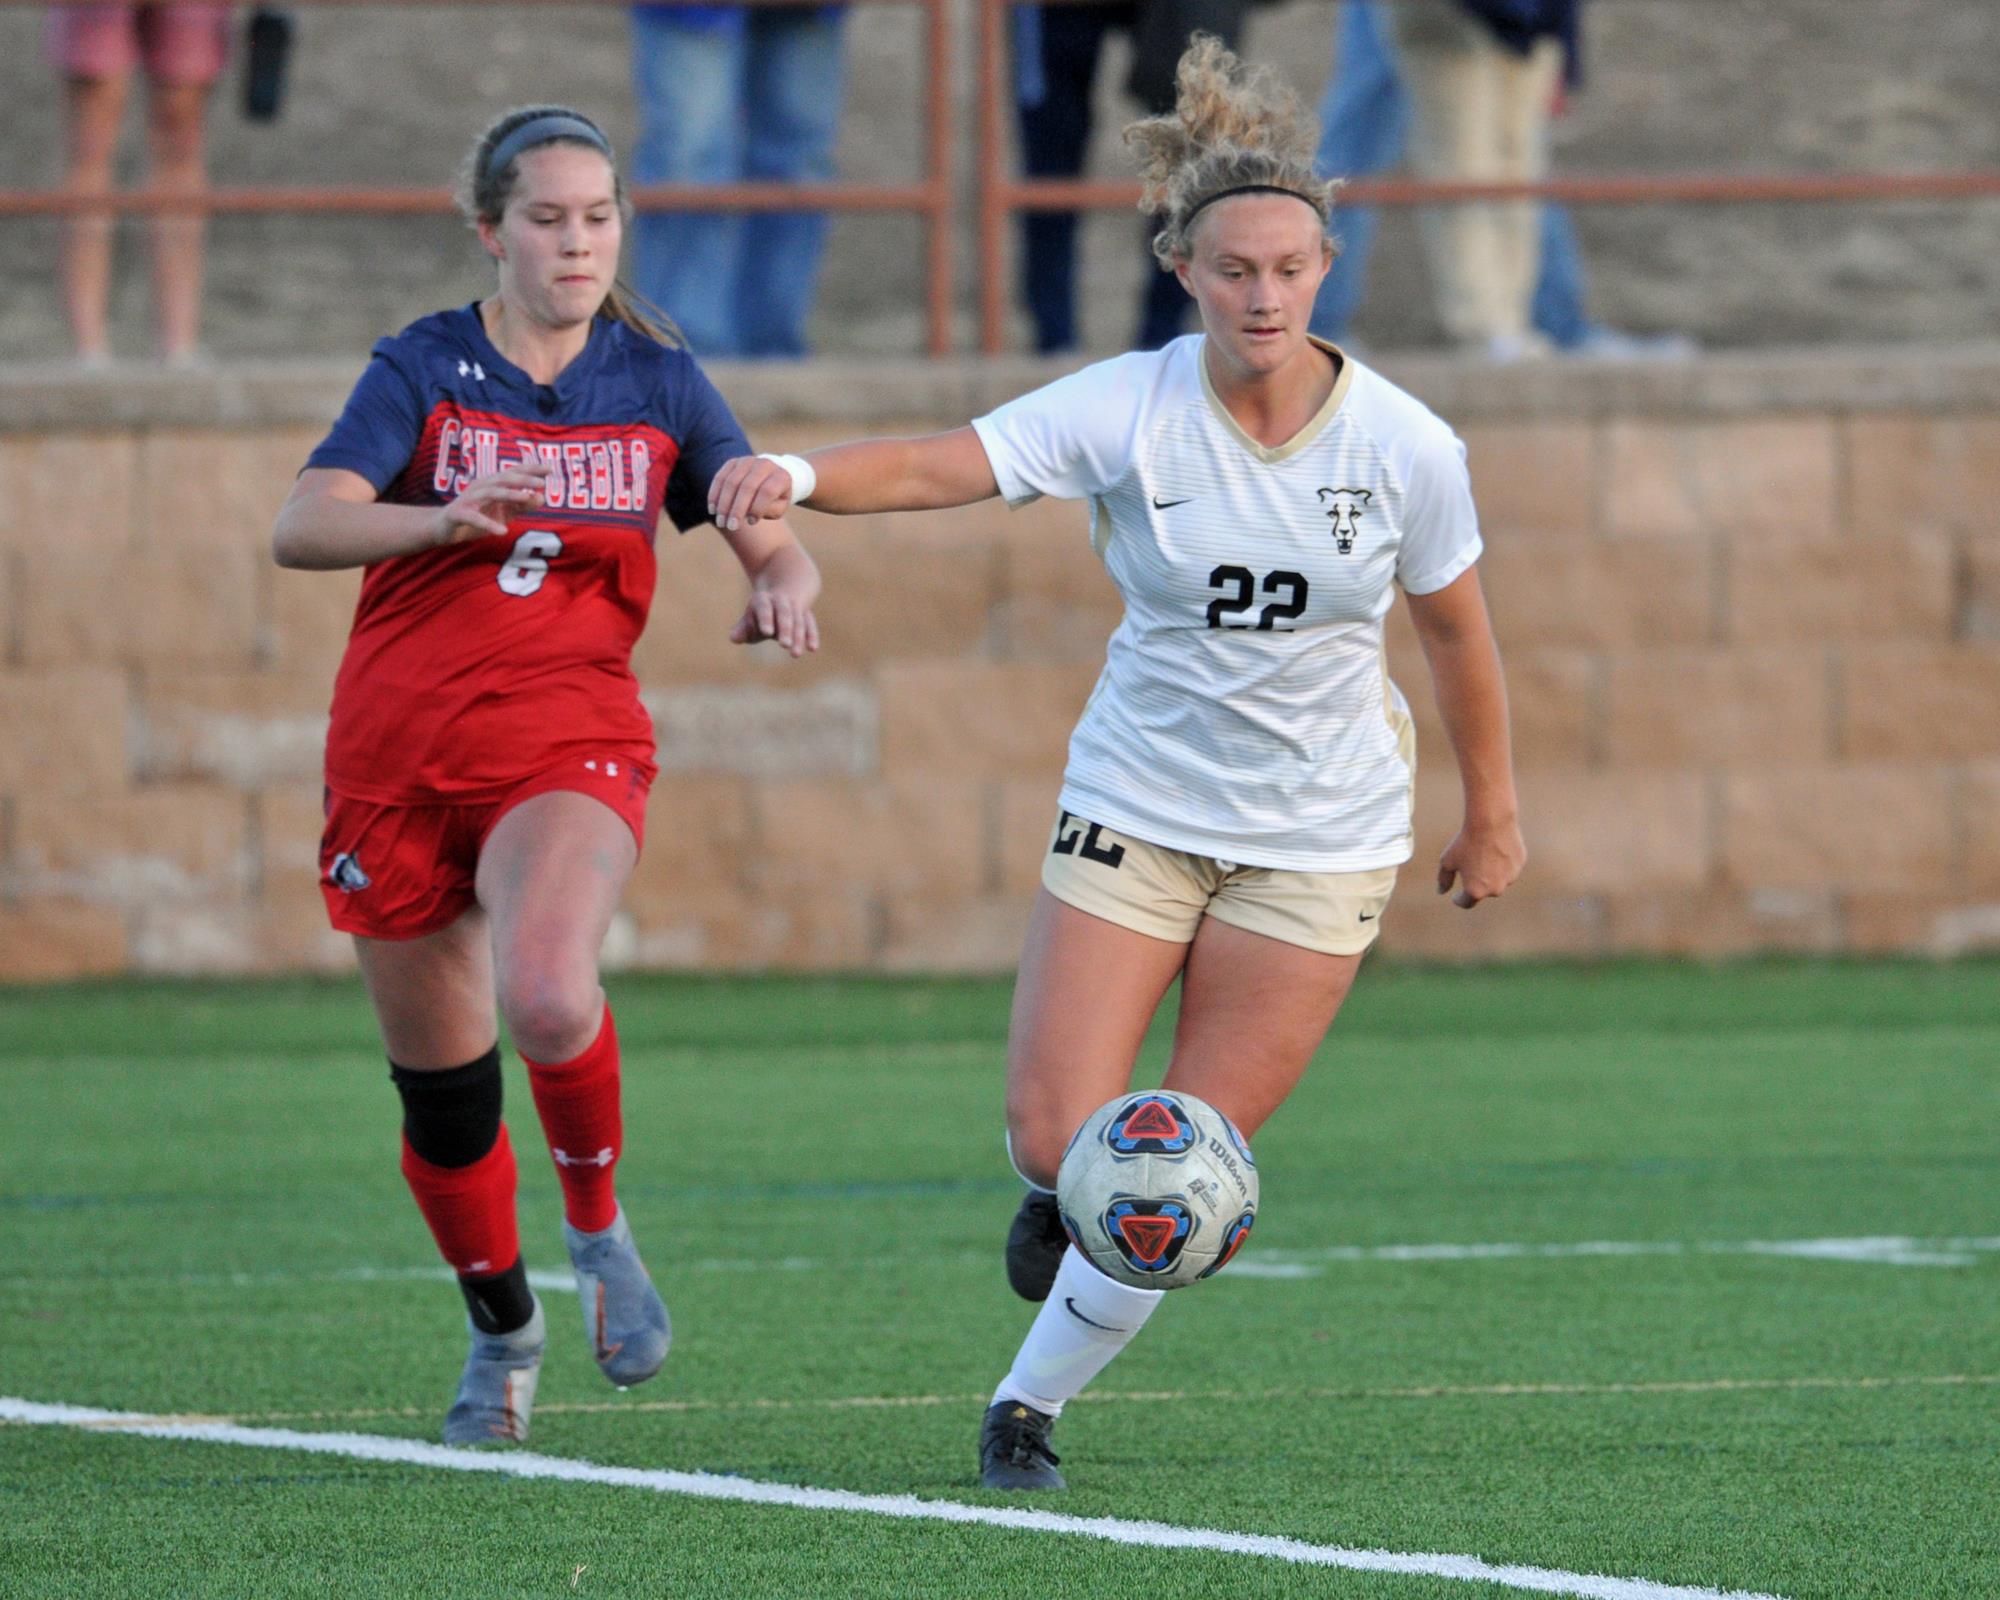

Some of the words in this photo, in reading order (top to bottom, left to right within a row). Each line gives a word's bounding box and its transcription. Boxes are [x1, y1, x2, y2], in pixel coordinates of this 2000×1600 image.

[498, 530, 563, 597] 6
[1206, 564, 1308, 632] 22
[1209, 1137, 1247, 1197] Wilson
